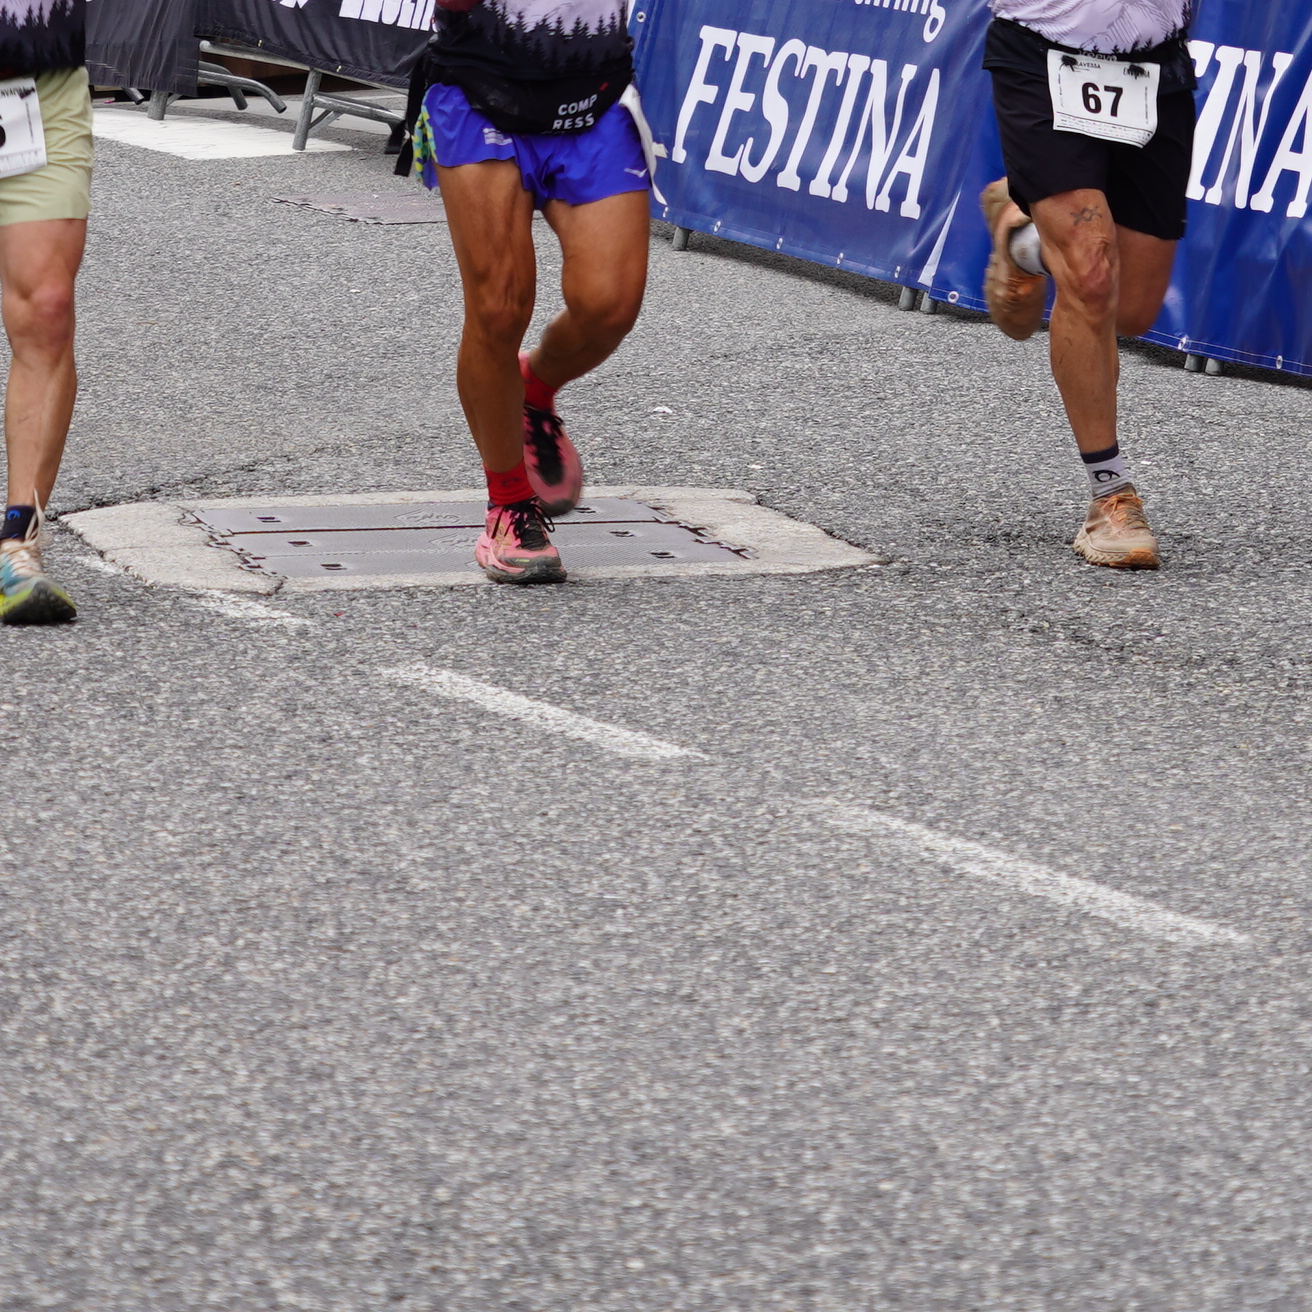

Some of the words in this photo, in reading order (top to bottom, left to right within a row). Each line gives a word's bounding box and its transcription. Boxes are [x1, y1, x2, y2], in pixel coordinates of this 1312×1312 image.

[557, 93, 598, 116] COMP
[1081, 82, 1124, 118] 67
[552, 112, 595, 130] RESS
[671, 25, 941, 221] FESTINA
